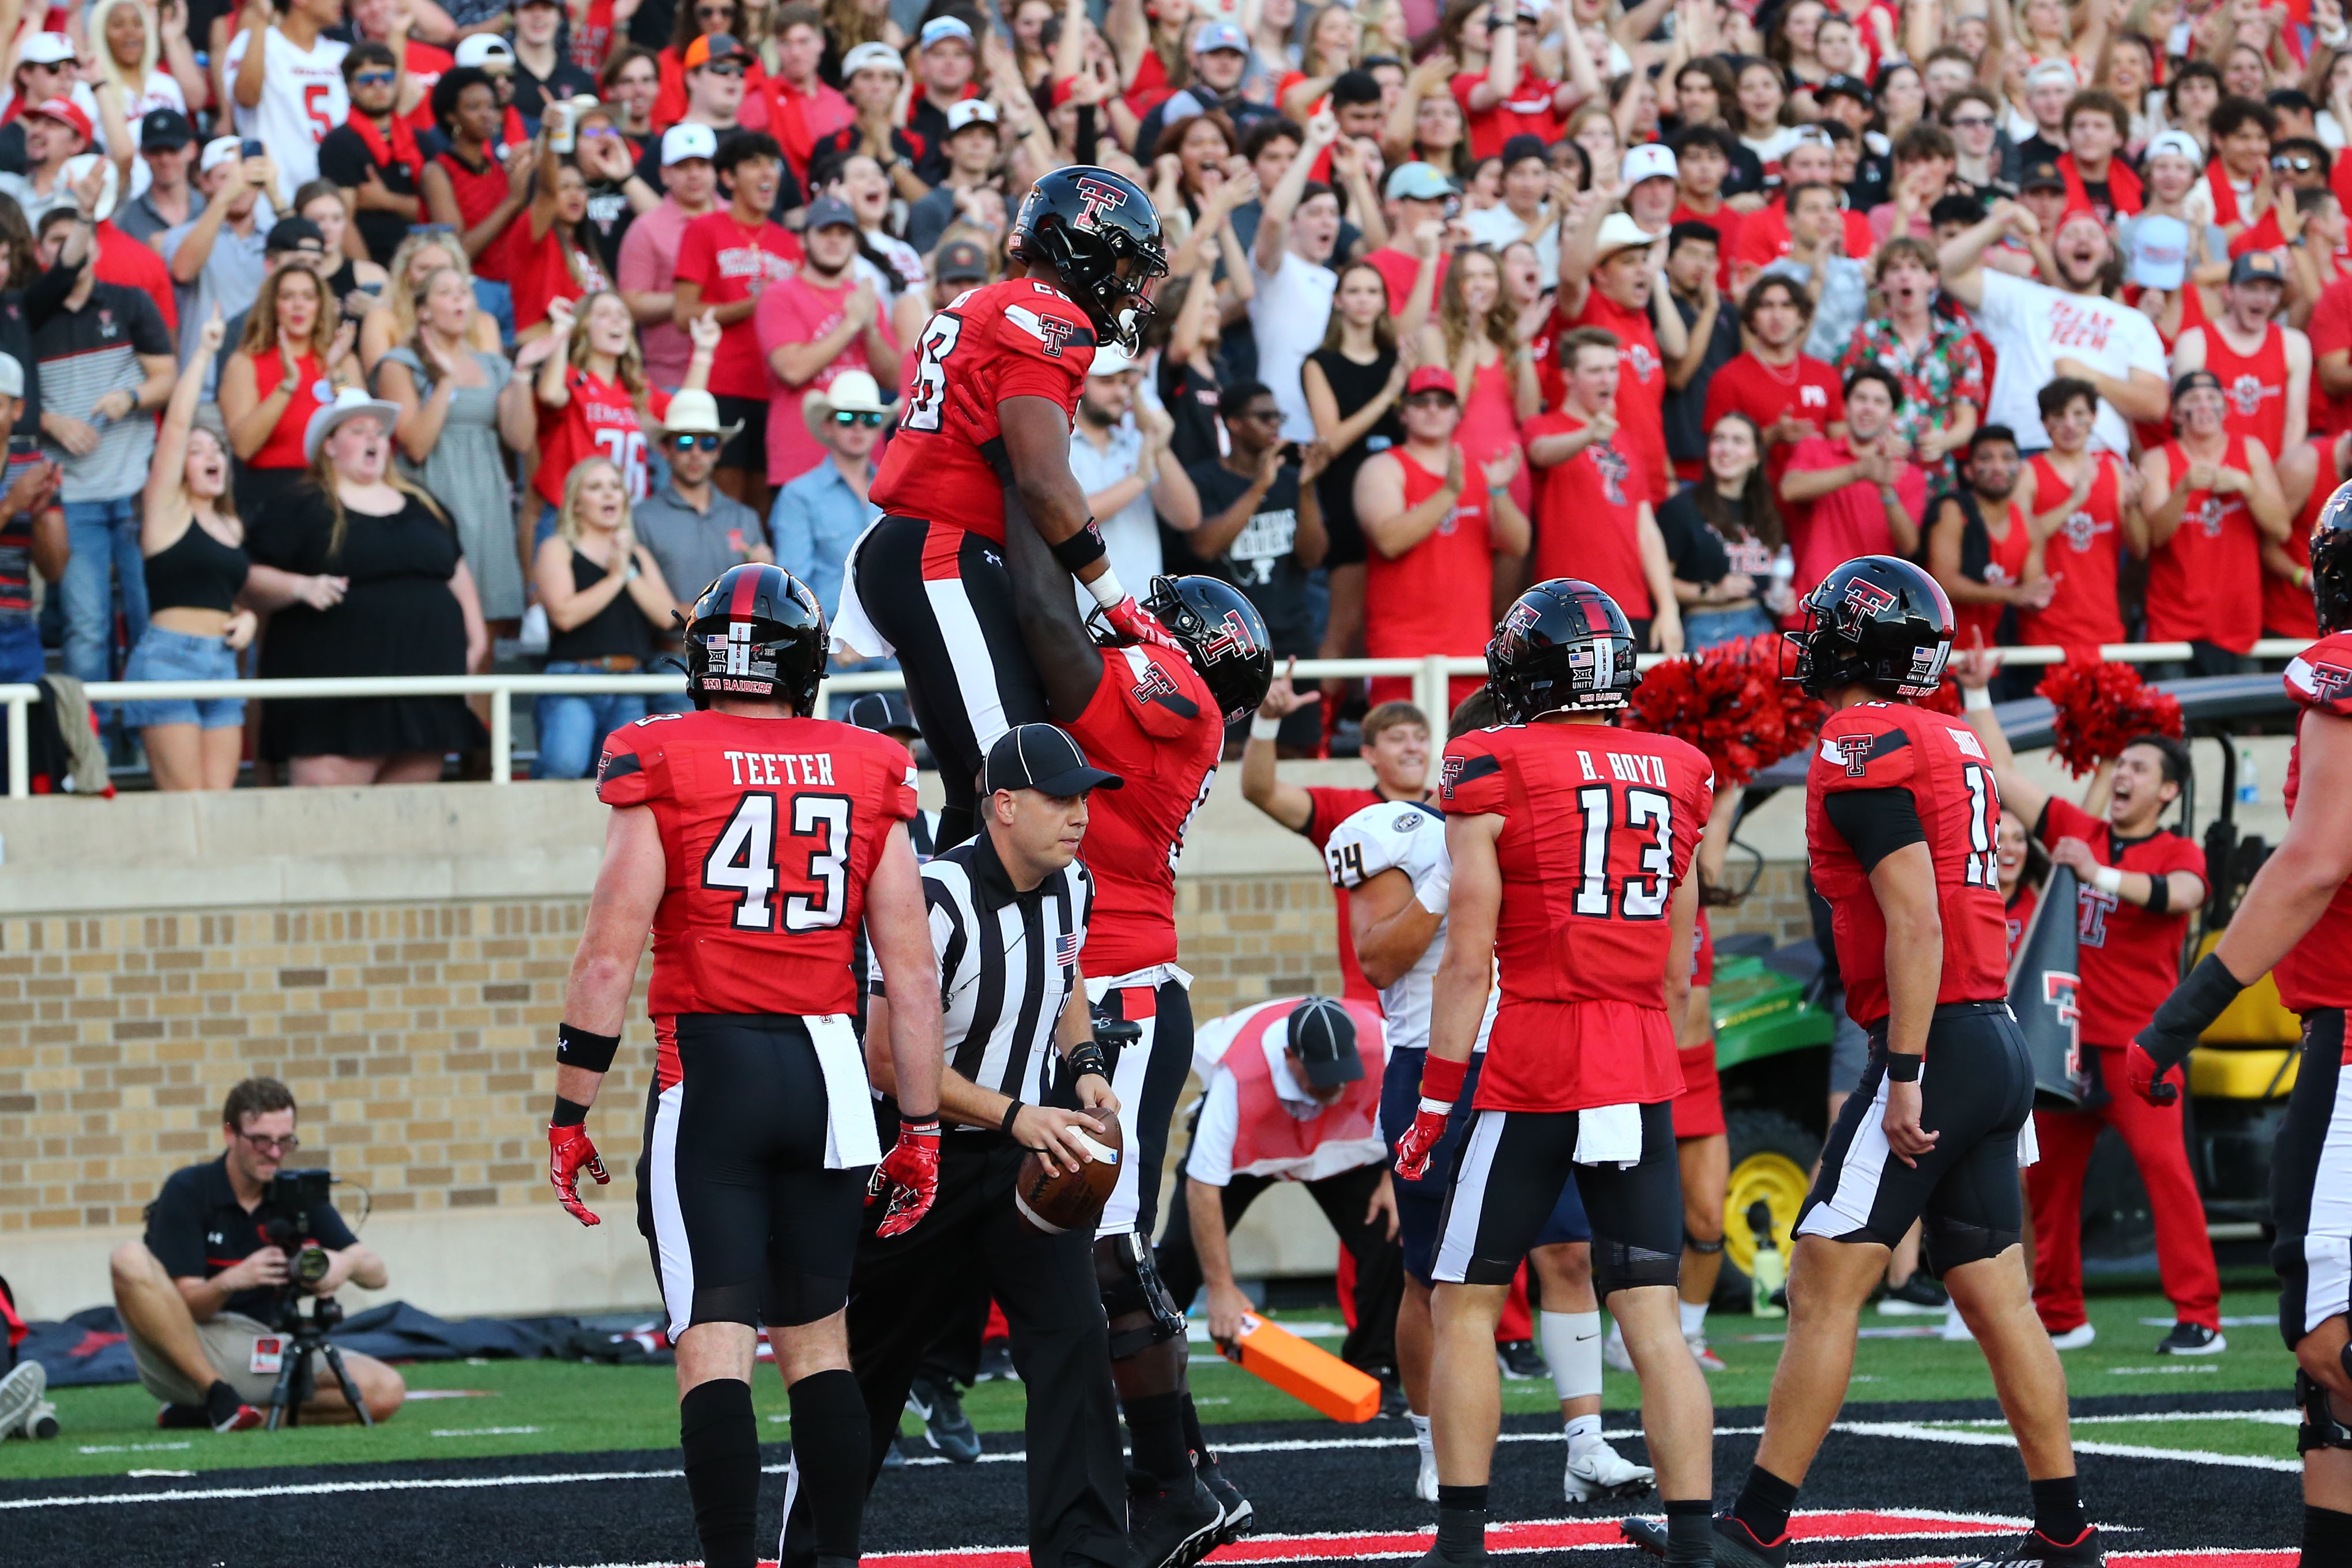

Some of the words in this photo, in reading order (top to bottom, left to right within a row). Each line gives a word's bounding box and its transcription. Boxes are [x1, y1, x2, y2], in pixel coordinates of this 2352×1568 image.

[303, 84, 333, 144] 5
[708, 664, 727, 673] UNITY
[1572, 681, 1593, 689] UNITY
[702, 678, 721, 691] RED
[722, 679, 773, 695] RAIDERS
[1579, 693, 1595, 703] RED
[1595, 692, 1623, 702] RAIDERS
[723, 751, 836, 786] TEETER
[1575, 750, 1605, 781] B.
[1605, 752, 1668, 788] BOYD
[703, 790, 854, 934] 43
[1571, 783, 1674, 921] 13
